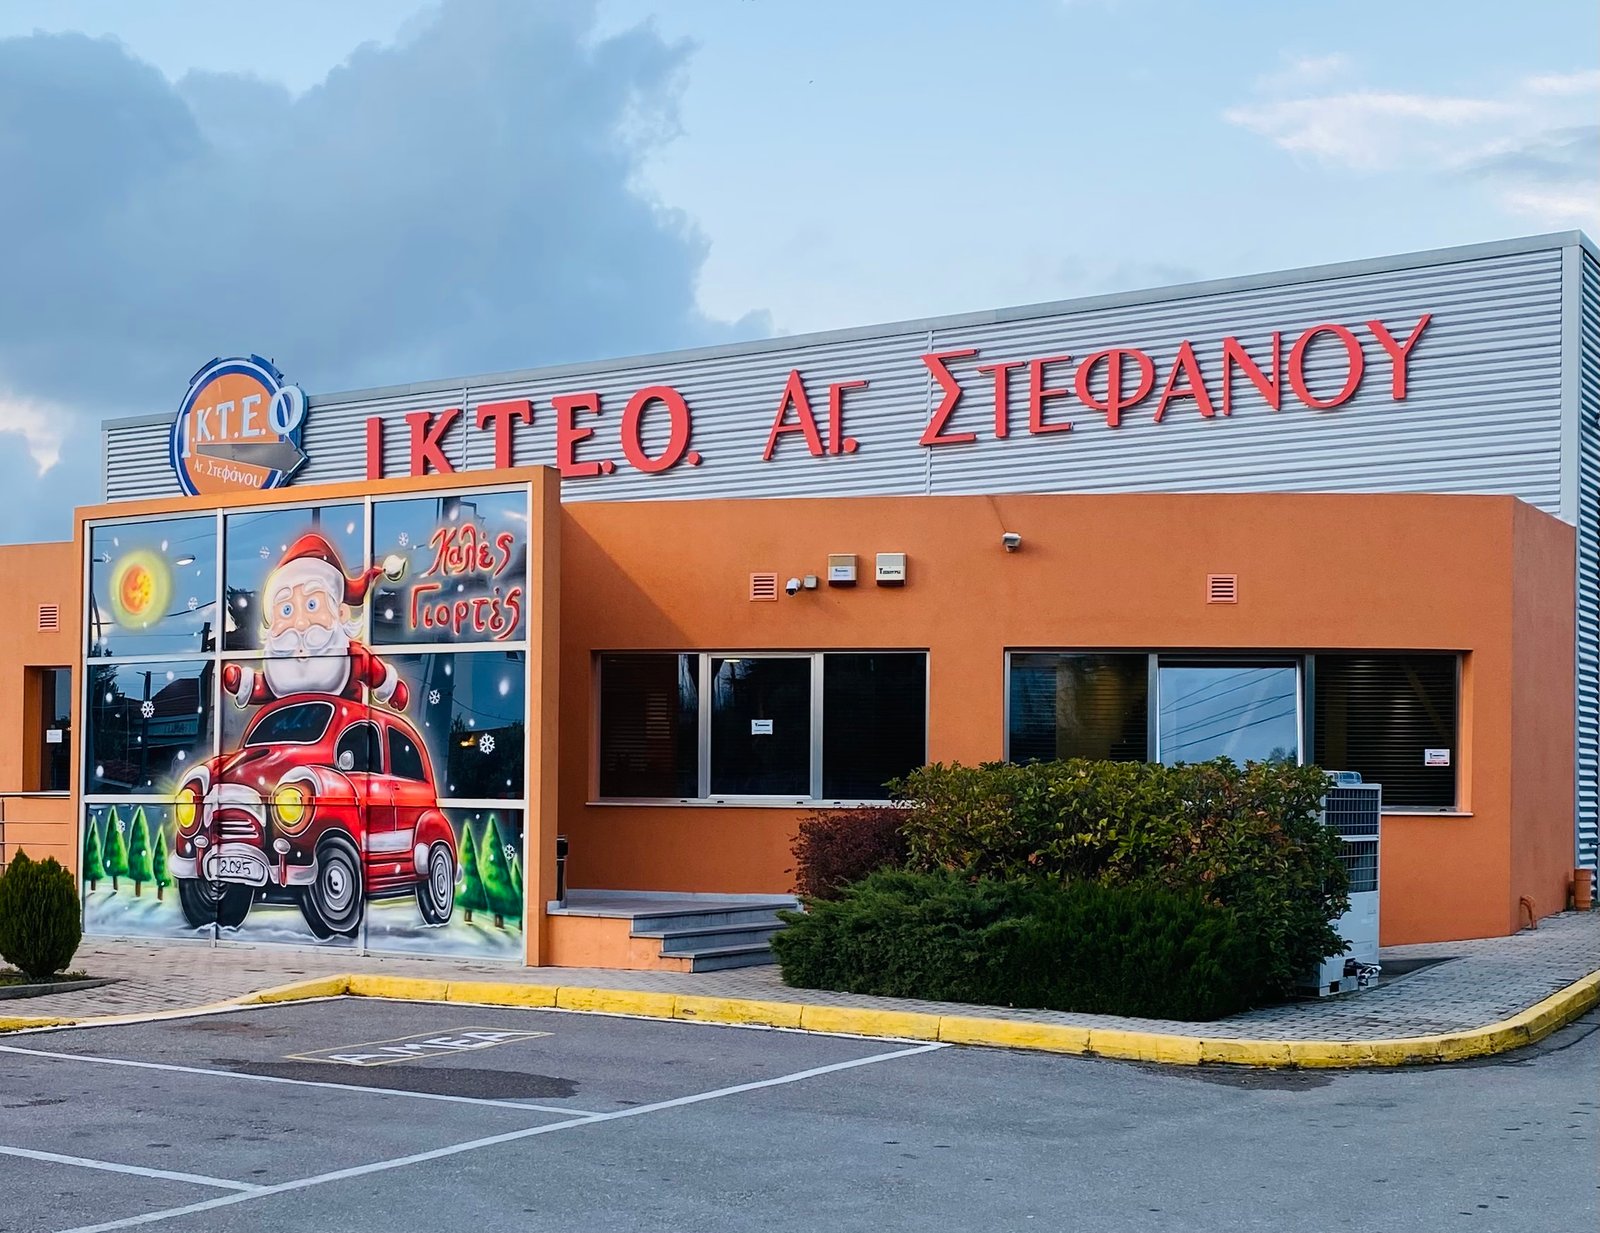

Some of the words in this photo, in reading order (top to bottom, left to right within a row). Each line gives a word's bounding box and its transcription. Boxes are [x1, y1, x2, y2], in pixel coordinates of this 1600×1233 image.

[918, 313, 1433, 447] ΣΤΕΦΑΝΟΥ
[420, 523, 514, 579] Καλές
[411, 586, 522, 641] Γιορτές
